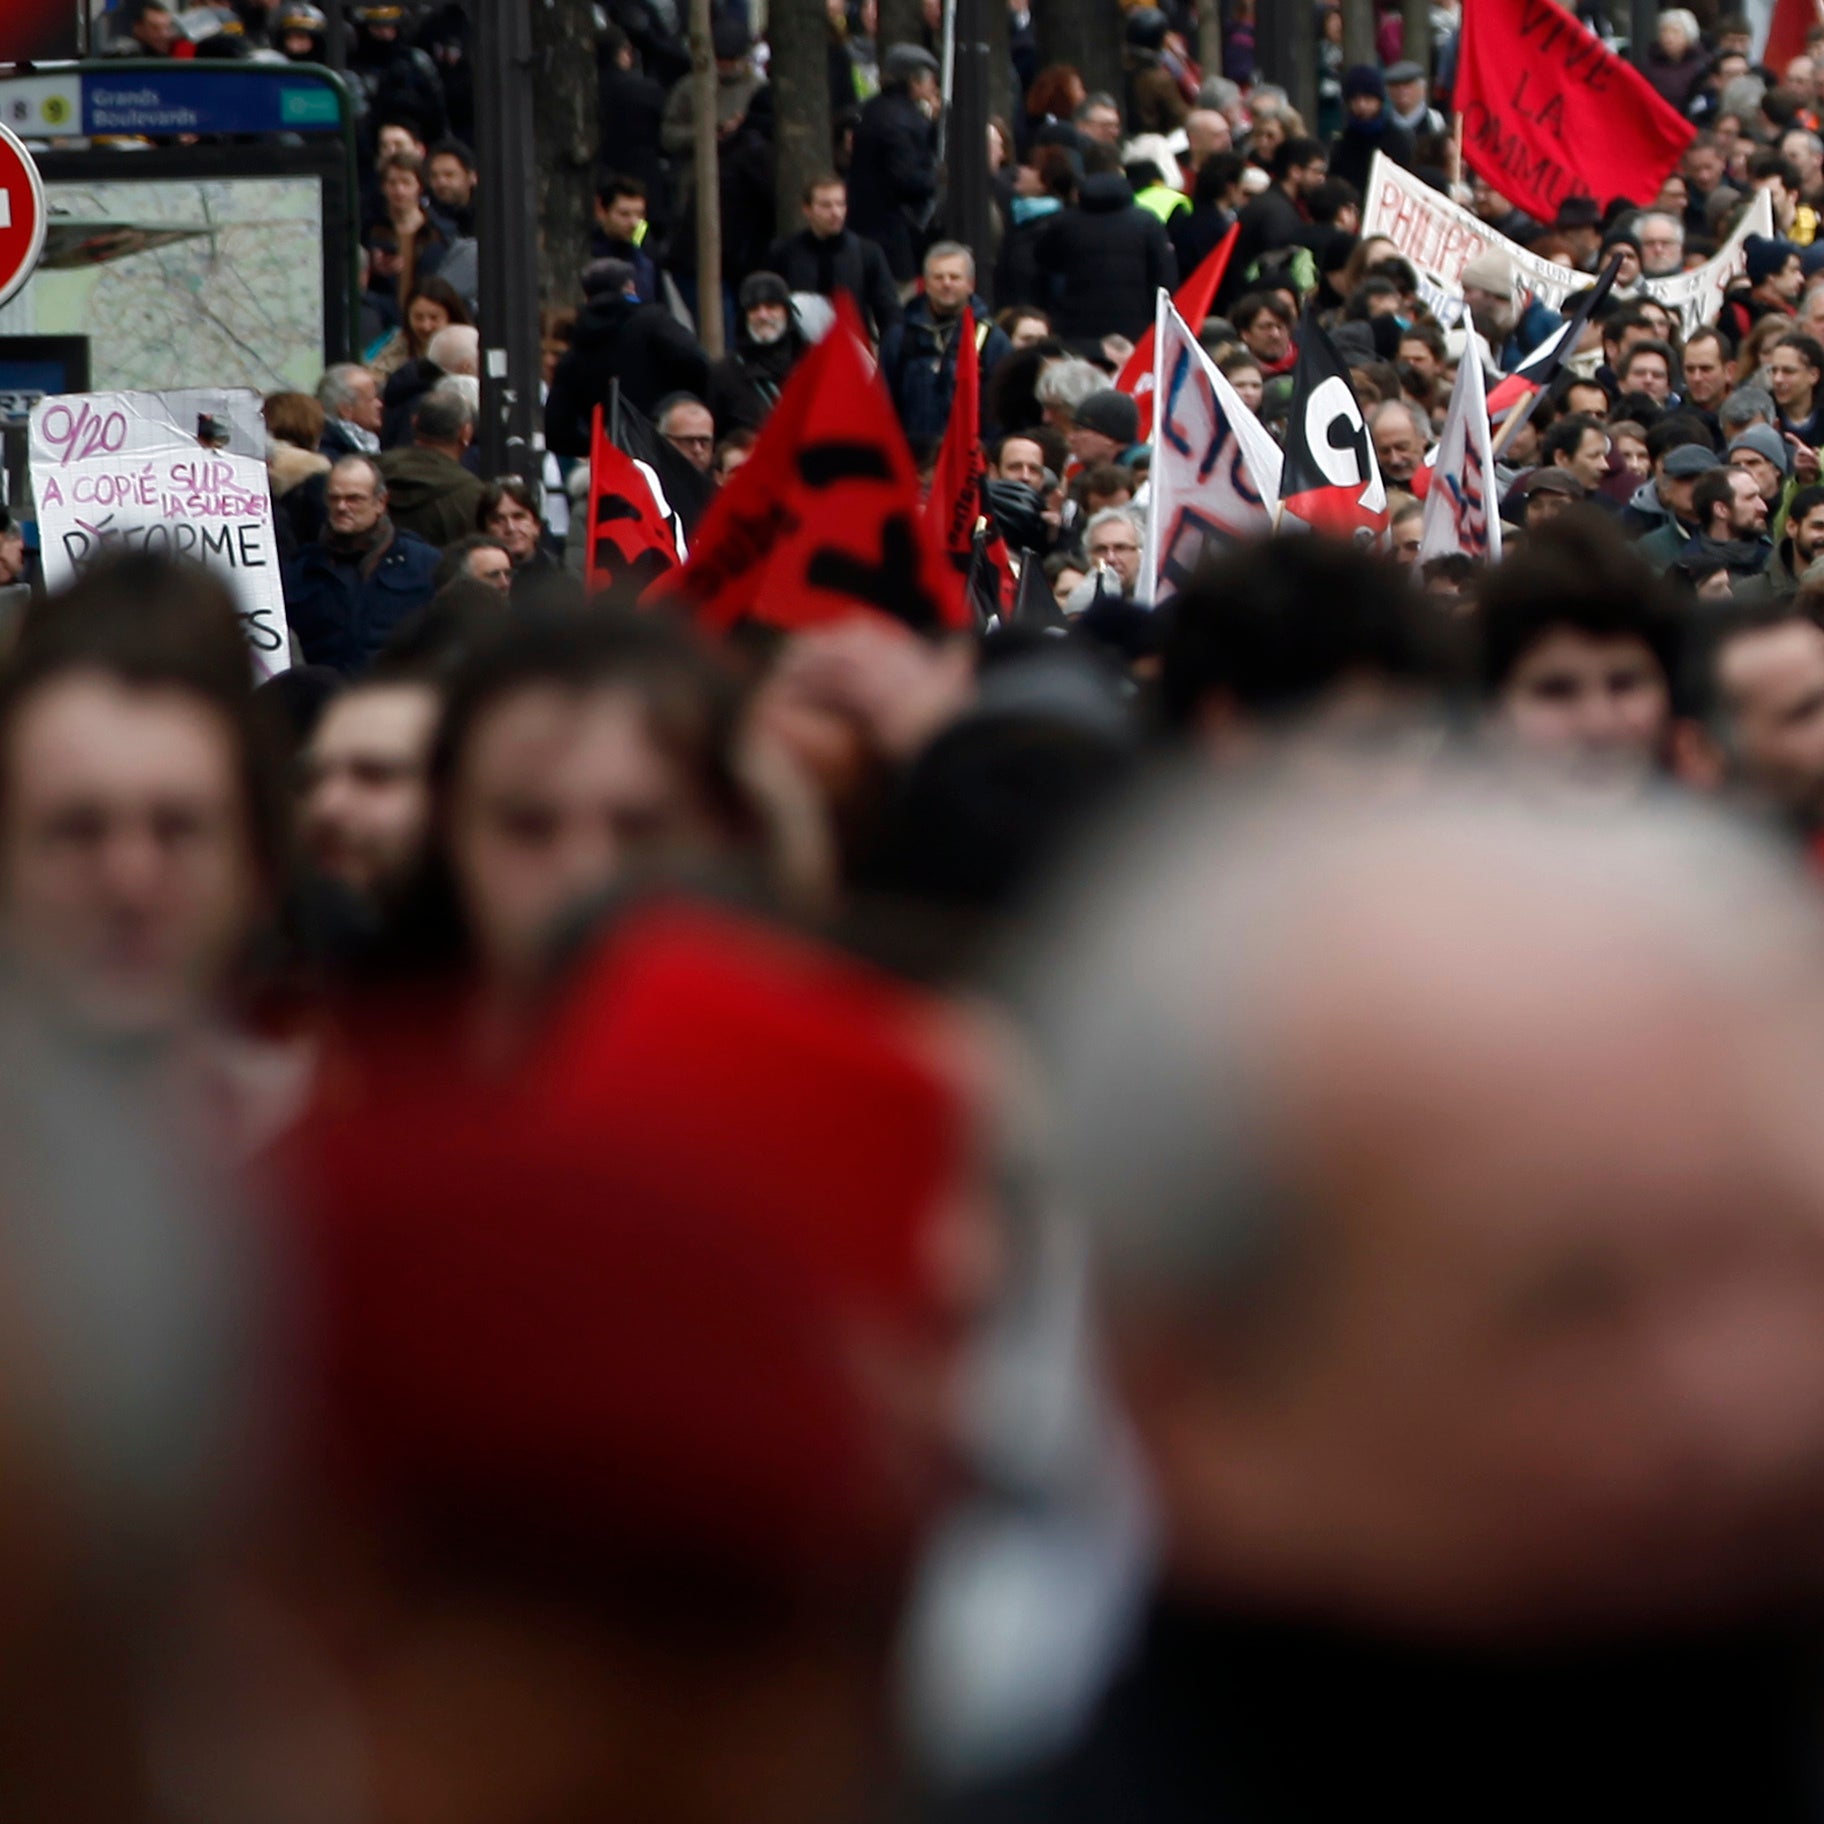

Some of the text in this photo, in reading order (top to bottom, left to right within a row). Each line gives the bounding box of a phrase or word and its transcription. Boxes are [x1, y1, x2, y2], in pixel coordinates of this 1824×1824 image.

[91, 87, 160, 108] Grands
[91, 109, 198, 129] Boulevards
[1511, 70, 1568, 141] LA
[41, 401, 128, 468] 0/20
[41, 475, 64, 511] A
[169, 460, 250, 495] SUR
